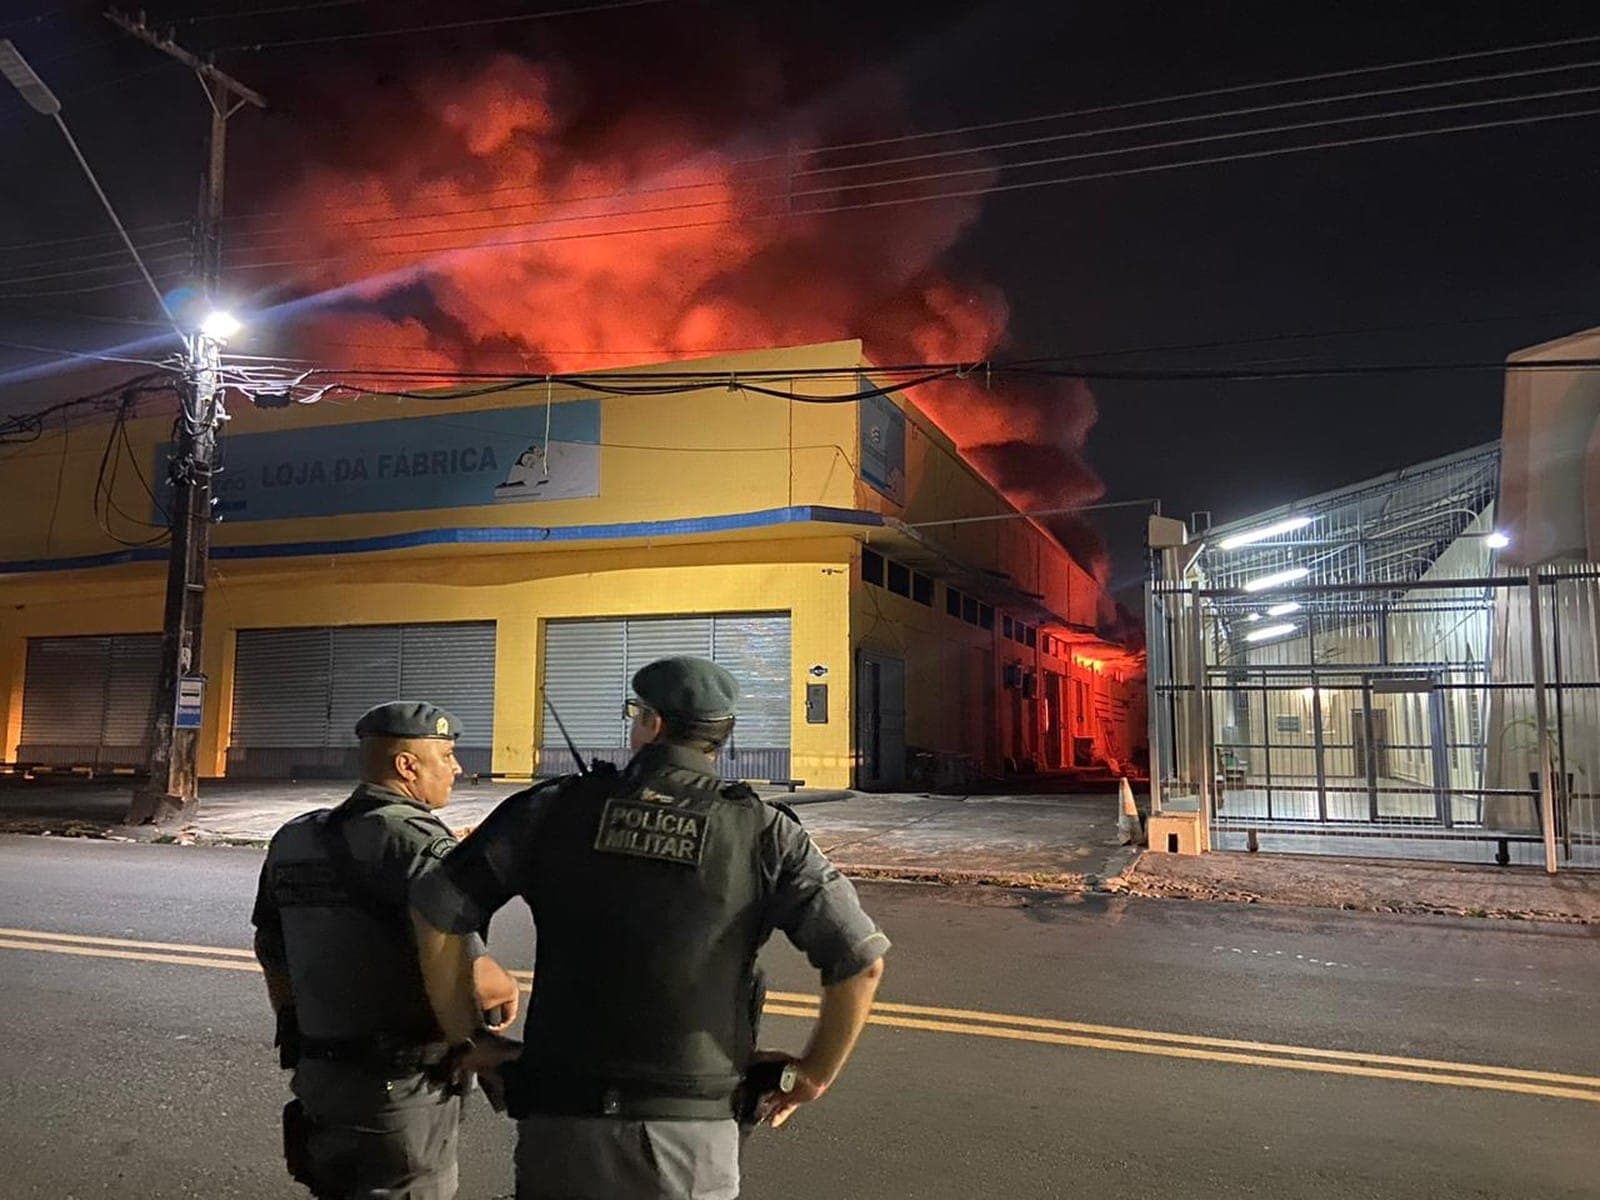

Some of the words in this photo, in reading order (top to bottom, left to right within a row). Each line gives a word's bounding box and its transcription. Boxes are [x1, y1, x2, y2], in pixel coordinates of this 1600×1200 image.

[262, 460, 325, 488] LOJA
[335, 456, 368, 482] DA
[377, 445, 498, 478] FÁBRICA
[611, 807, 698, 838] POLÍCIA
[604, 829, 695, 859] MILITAR
